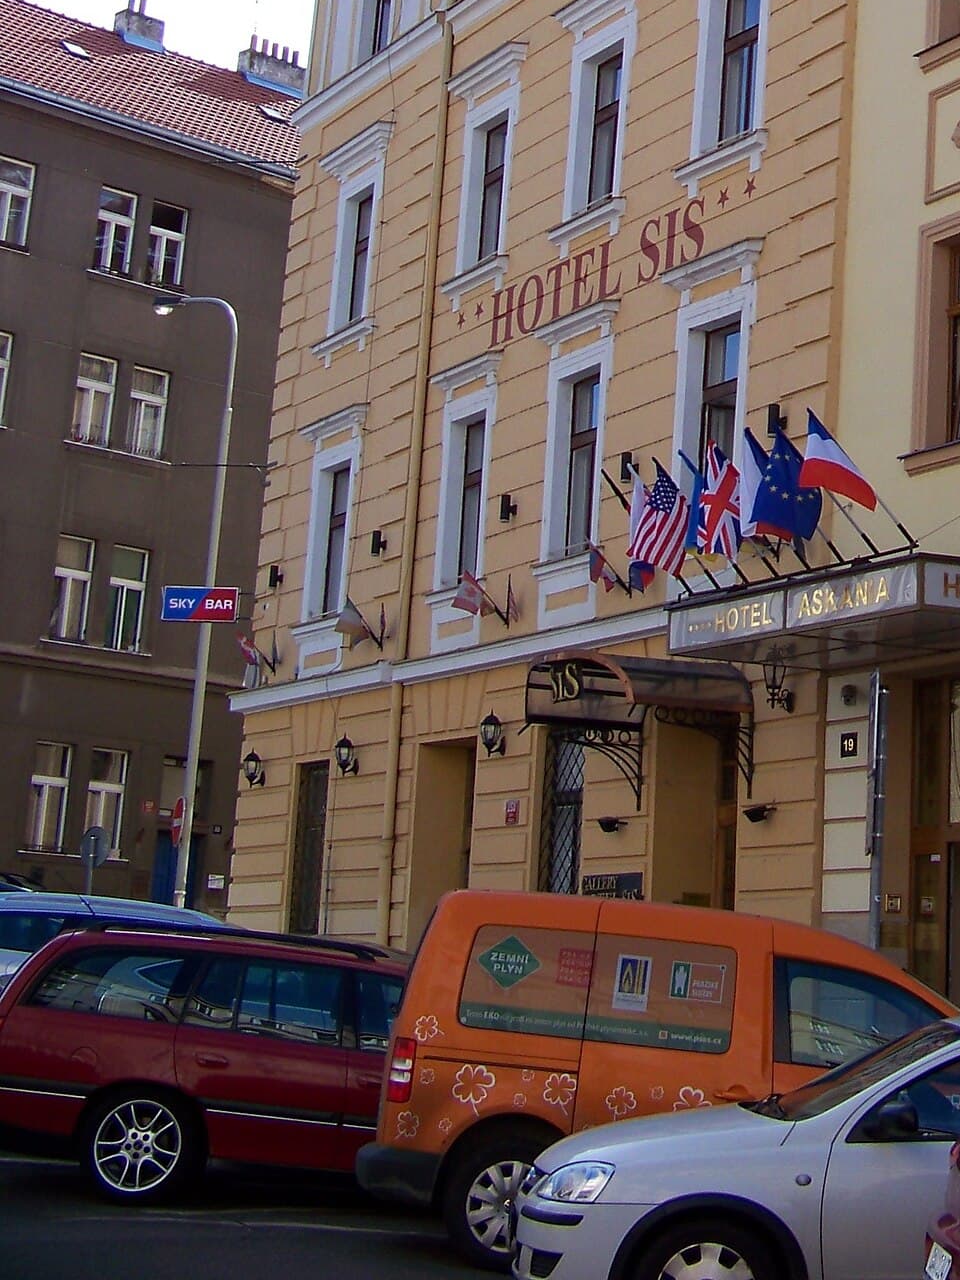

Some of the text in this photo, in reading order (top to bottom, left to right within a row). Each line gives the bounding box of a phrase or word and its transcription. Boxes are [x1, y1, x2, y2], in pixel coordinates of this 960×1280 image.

[488, 196, 706, 348] HOTEL SIS
[169, 598, 233, 610] SKY BAR
[714, 601, 773, 632] HOTEL
[549, 663, 580, 702] SIS
[843, 738, 854, 752] 19
[490, 952, 530, 964] ZEMNÍ
[493, 963, 524, 974] PLYN
